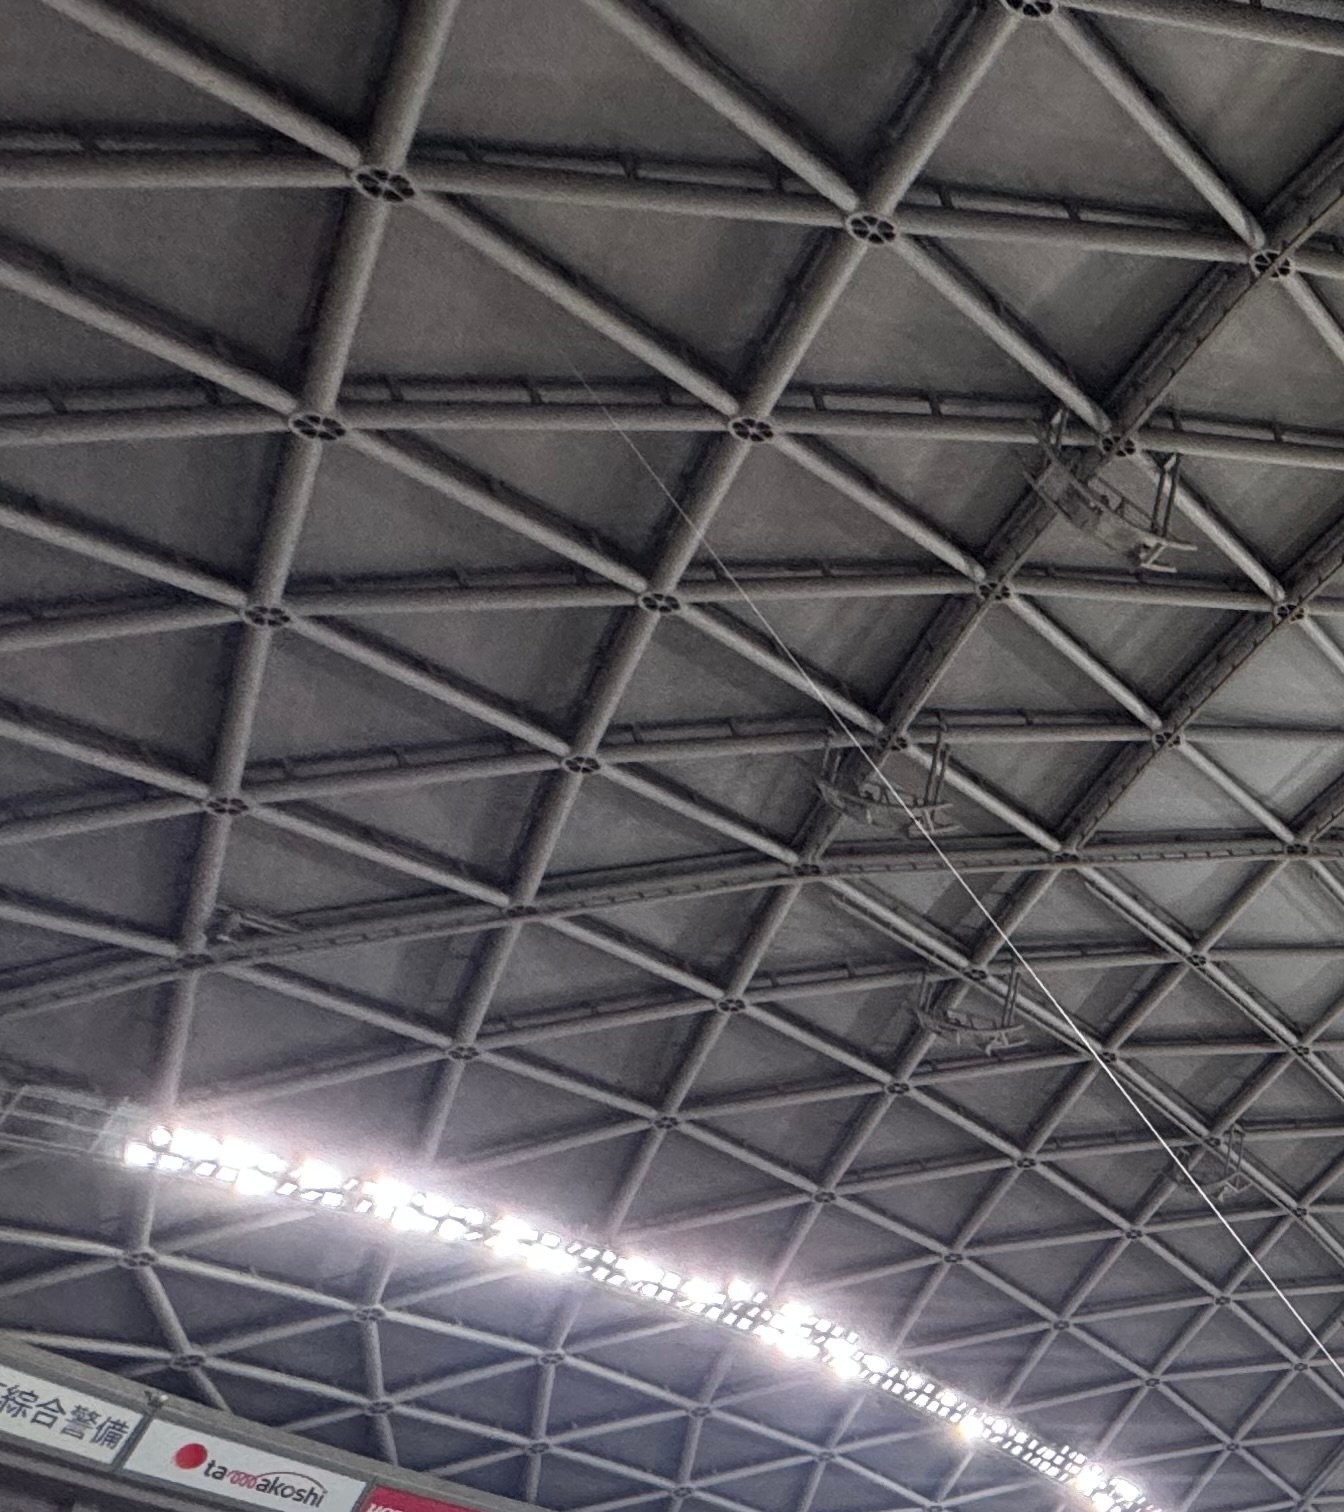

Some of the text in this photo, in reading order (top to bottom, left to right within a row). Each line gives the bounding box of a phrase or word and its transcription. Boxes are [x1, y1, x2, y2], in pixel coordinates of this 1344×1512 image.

[0, 1383, 130, 1450] 綜合警備
[204, 1458, 328, 1508] tamakoshi
